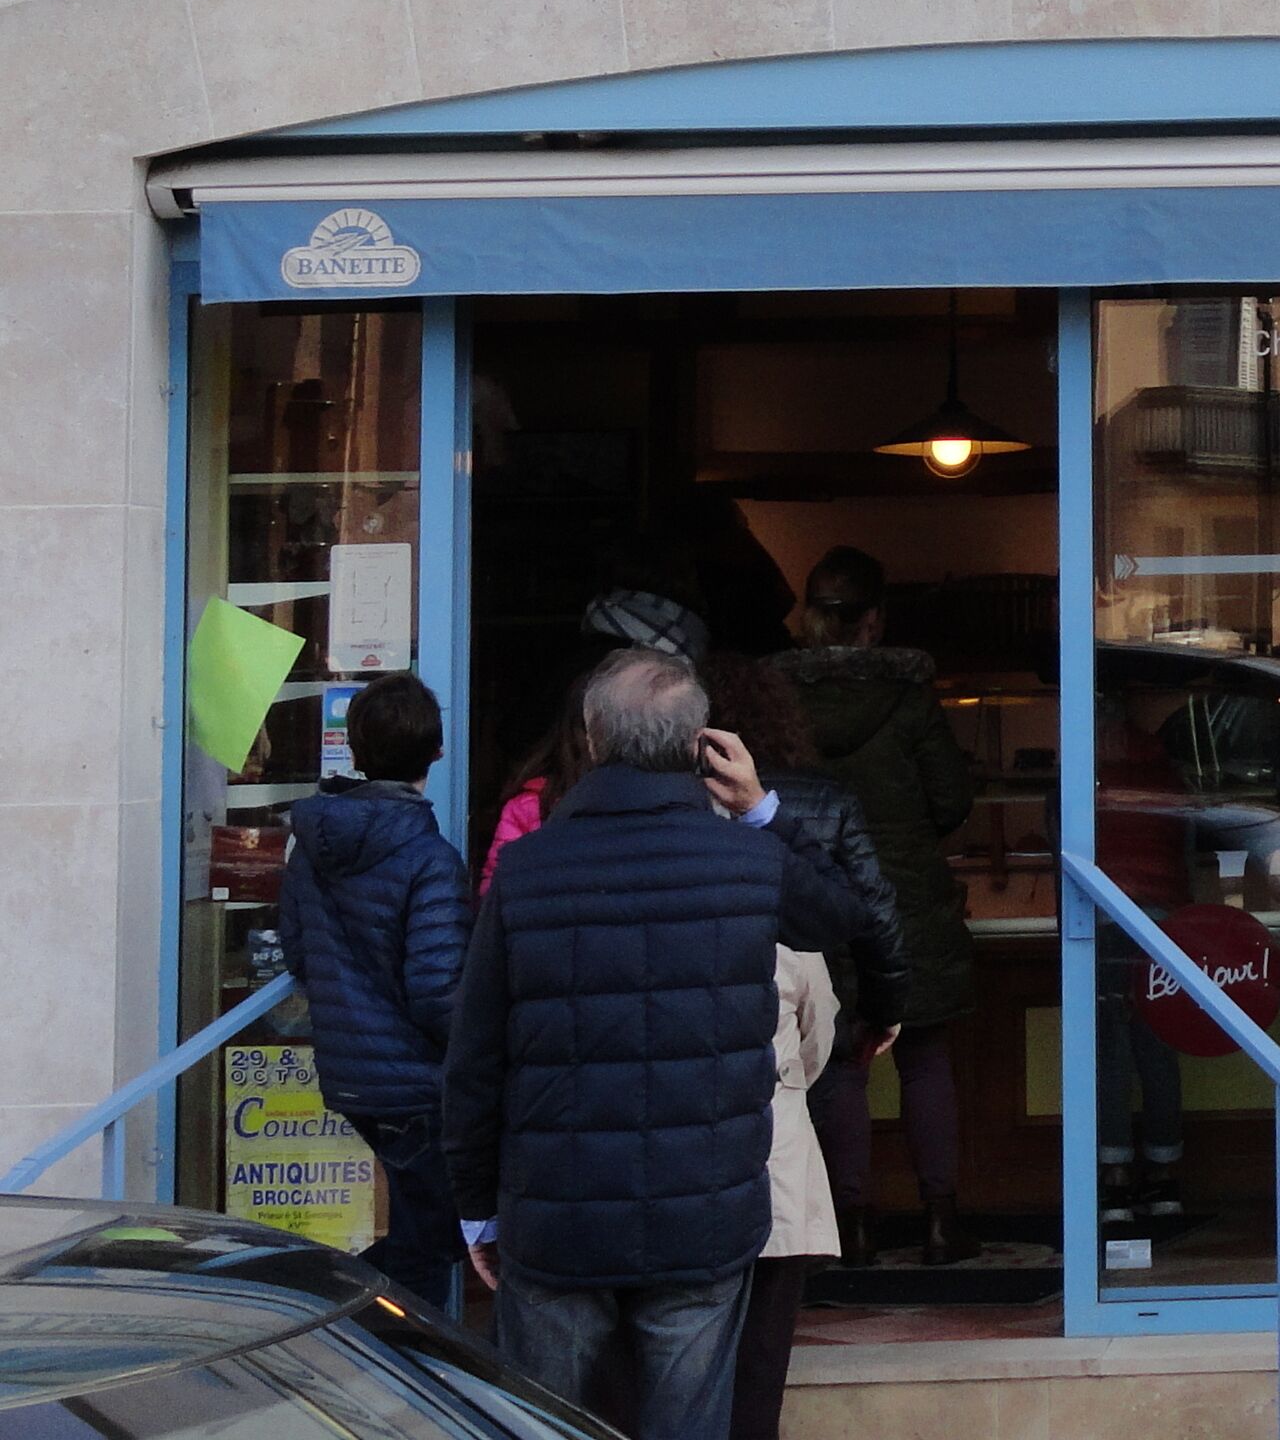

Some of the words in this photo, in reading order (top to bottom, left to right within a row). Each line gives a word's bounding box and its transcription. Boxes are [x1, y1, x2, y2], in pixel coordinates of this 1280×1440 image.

[296, 255, 406, 277] BANETTE
[231, 1049, 267, 1069] 29
[279, 1048, 298, 1068] &
[230, 1068, 312, 1085] OCTO
[233, 1096, 355, 1139] Couche
[232, 1156, 372, 1186] ANTIQUITÉS
[252, 1189, 352, 1206] BROCANTE
